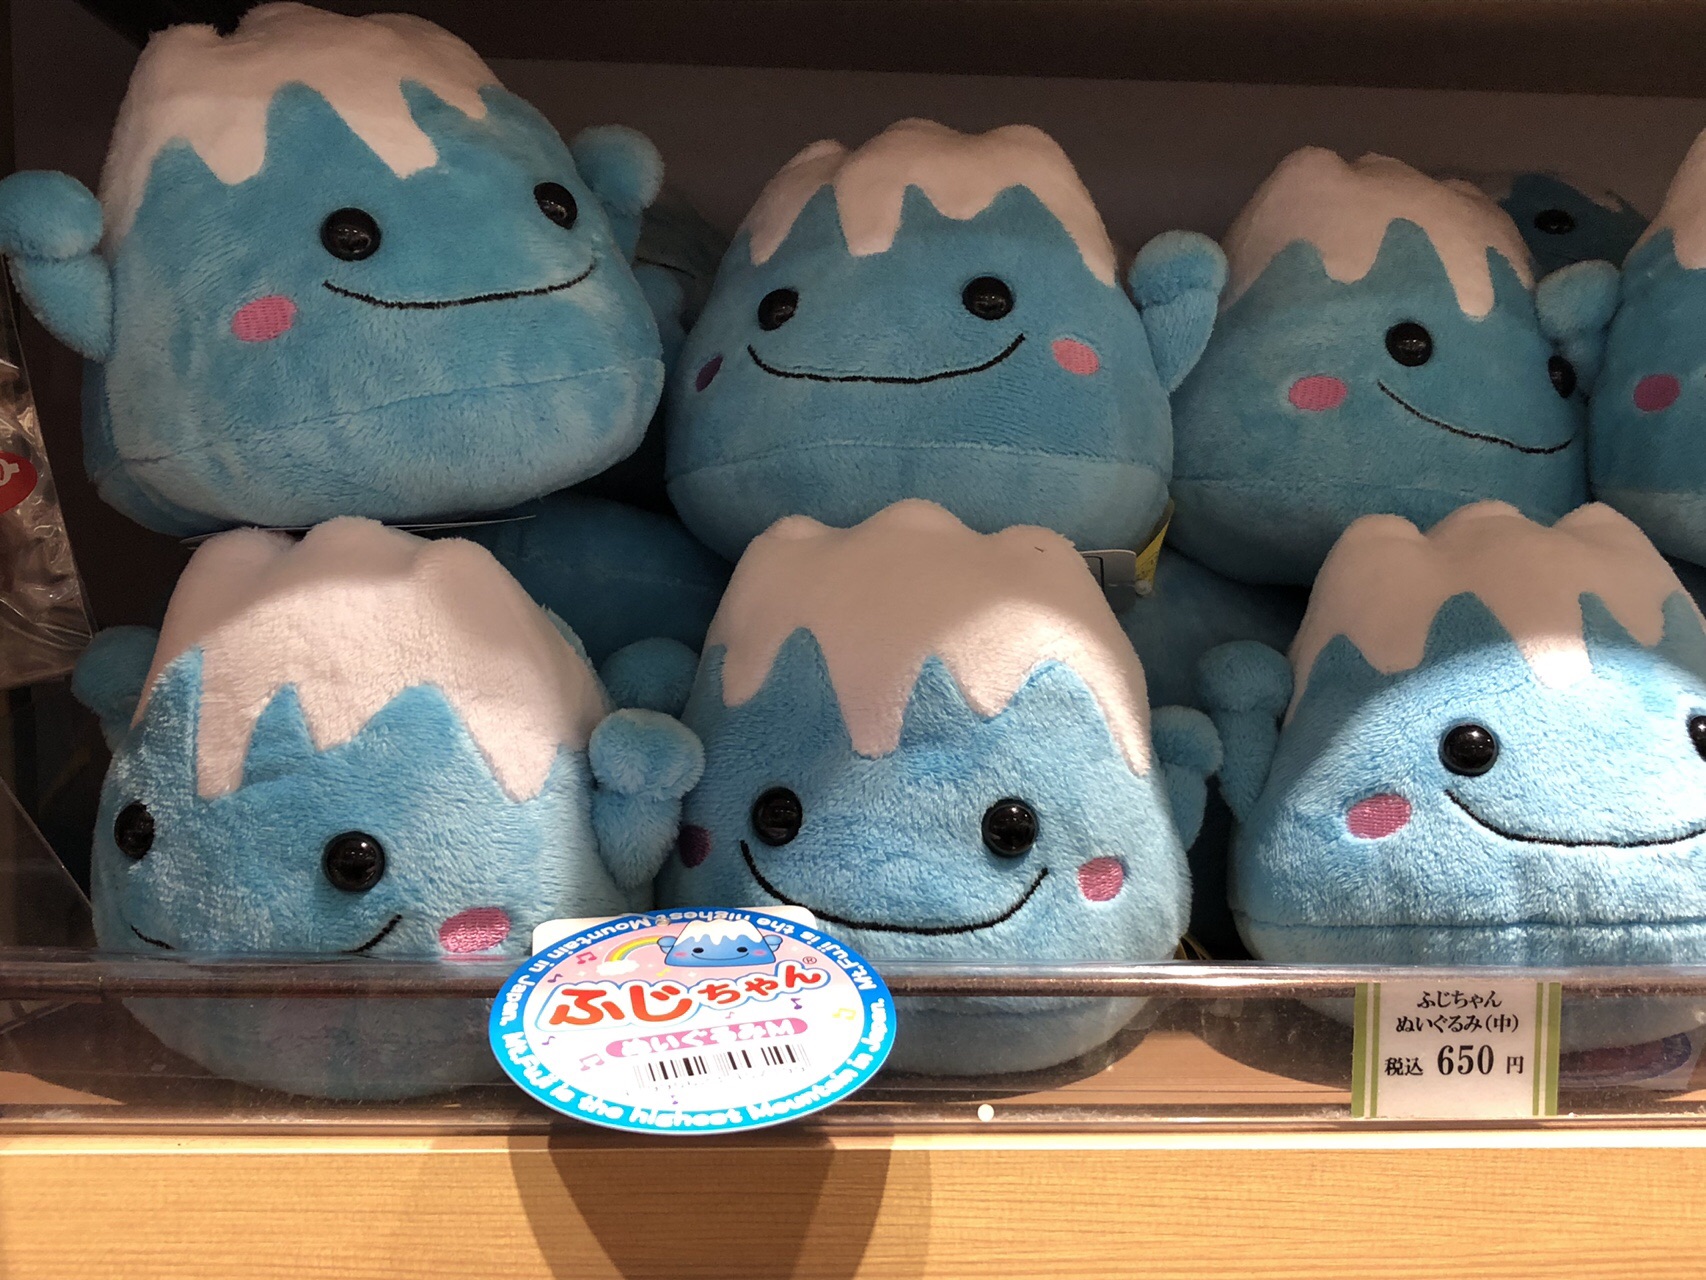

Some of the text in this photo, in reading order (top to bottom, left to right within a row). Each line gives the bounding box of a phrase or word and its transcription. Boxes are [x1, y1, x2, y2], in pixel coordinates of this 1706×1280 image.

[562, 916, 652, 955] Mountain
[756, 917, 796, 935] the
[799, 930, 823, 948] is
[528, 953, 562, 973] in
[500, 975, 536, 1027] Japan.
[549, 964, 822, 1026] ふじちゃん
[1417, 989, 1502, 1009] ふじちゃん
[1384, 1044, 1524, 1076] 税込 650 円
[549, 1082, 576, 1103] is
[577, 1094, 625, 1120] the
[628, 1105, 743, 1129] highest
[746, 1068, 859, 1121] Mountain
[846, 1052, 874, 1071] in
